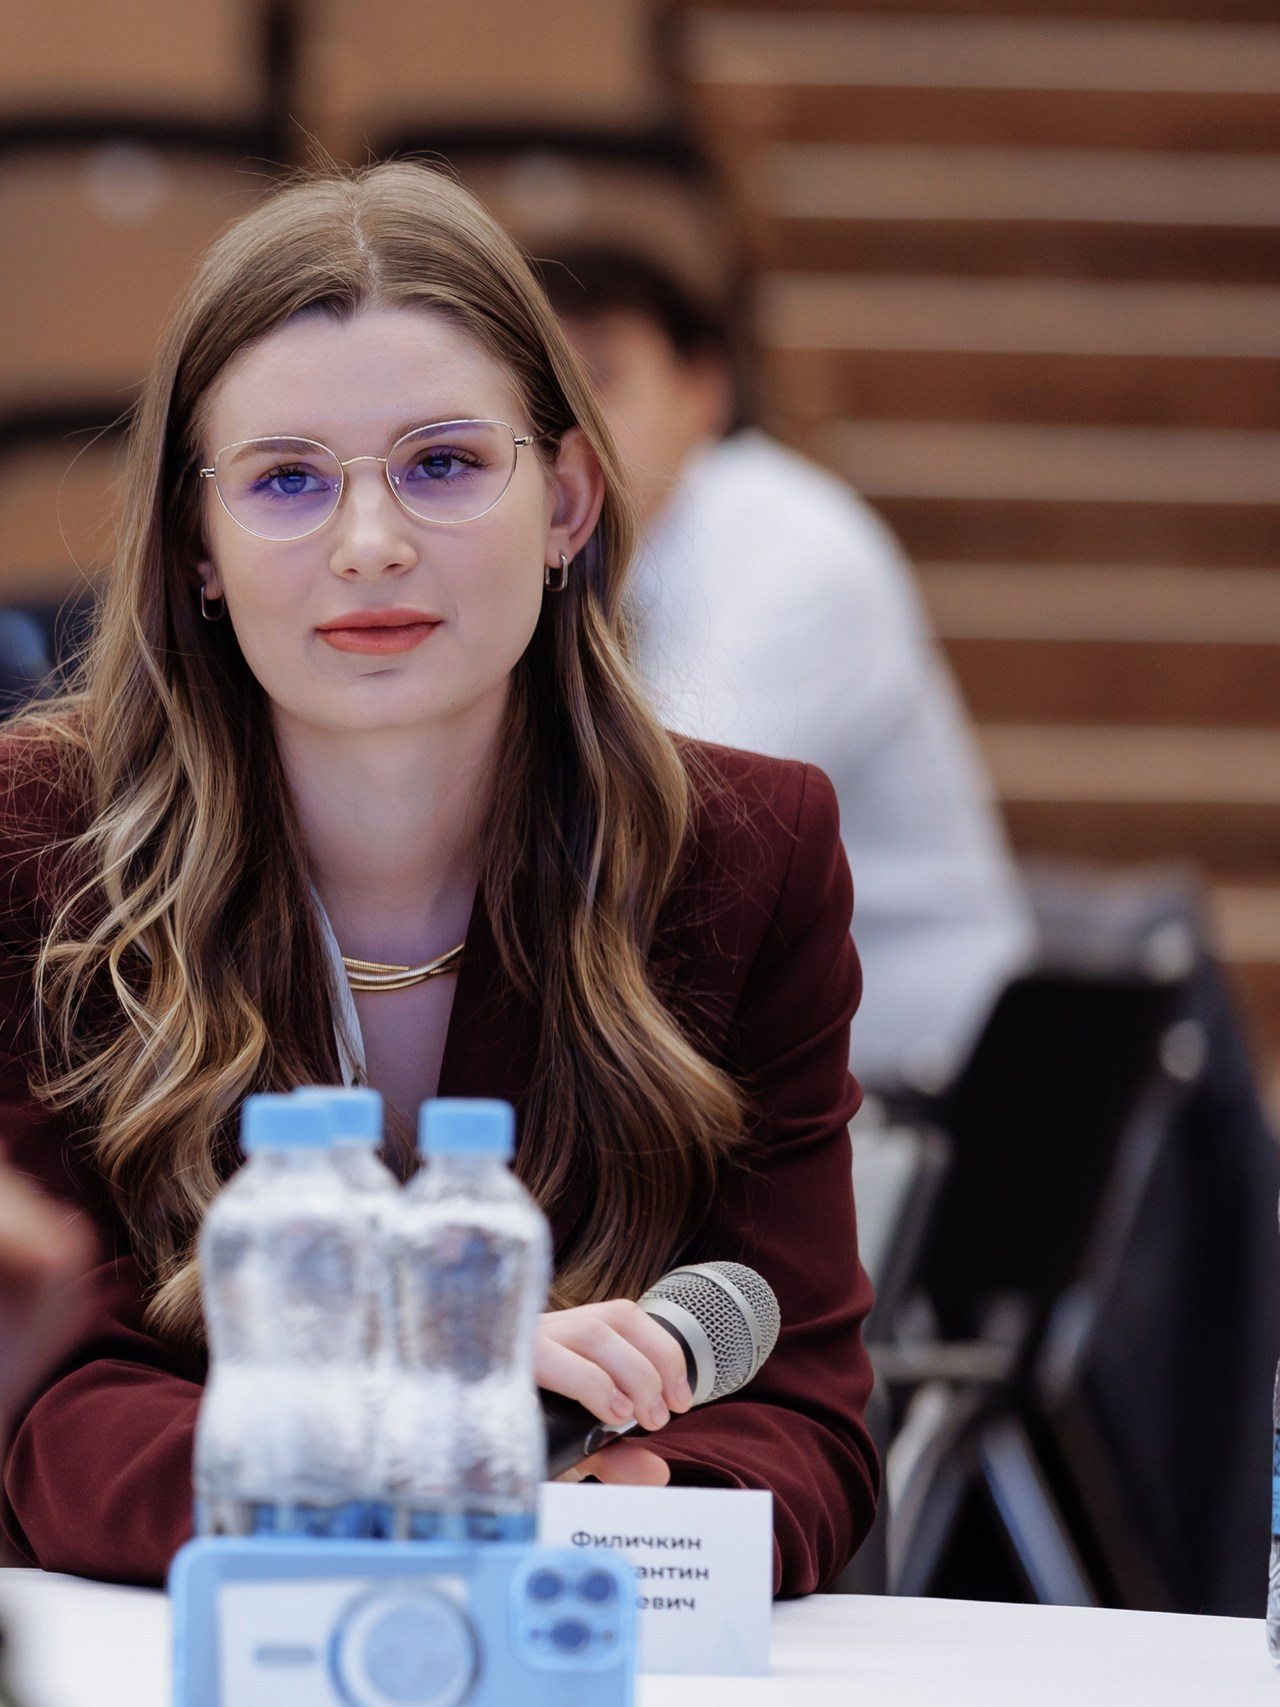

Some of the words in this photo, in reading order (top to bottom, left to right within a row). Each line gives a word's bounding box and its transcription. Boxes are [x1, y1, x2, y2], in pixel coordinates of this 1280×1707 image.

[571, 1531, 702, 1550] Филичкин
[634, 1566, 709, 1580] антин
[635, 1596, 696, 1610] евич
